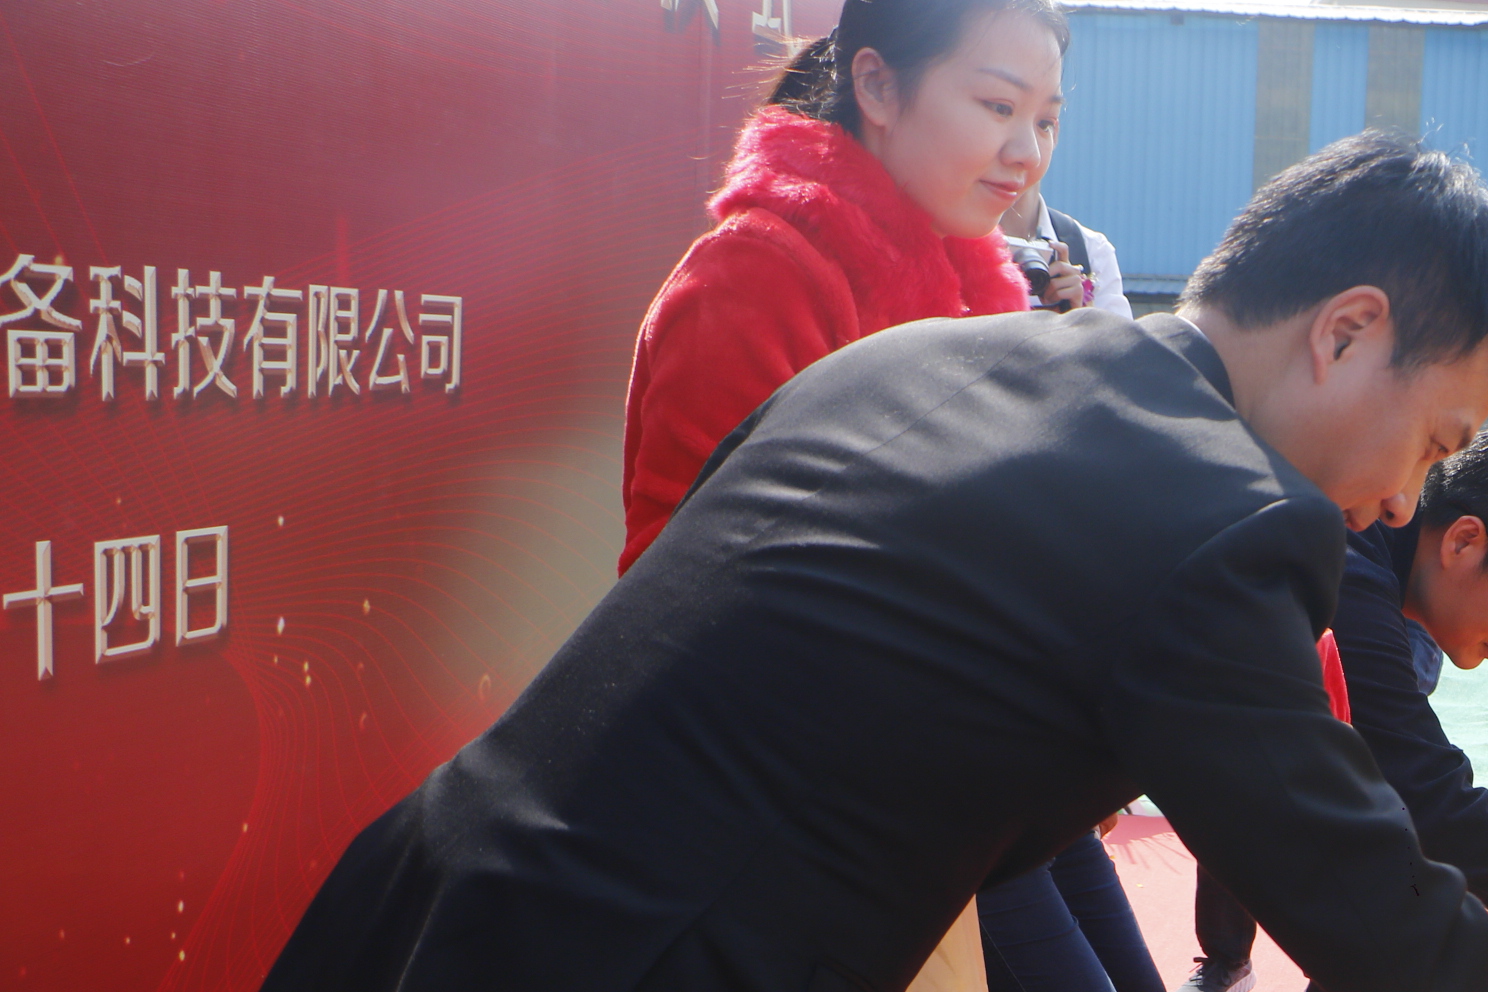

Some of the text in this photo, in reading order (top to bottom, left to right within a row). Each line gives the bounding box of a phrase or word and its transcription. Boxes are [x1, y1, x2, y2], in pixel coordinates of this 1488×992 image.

[0, 253, 463, 402] 备科技有限公司
[2, 524, 229, 681] 十四日
